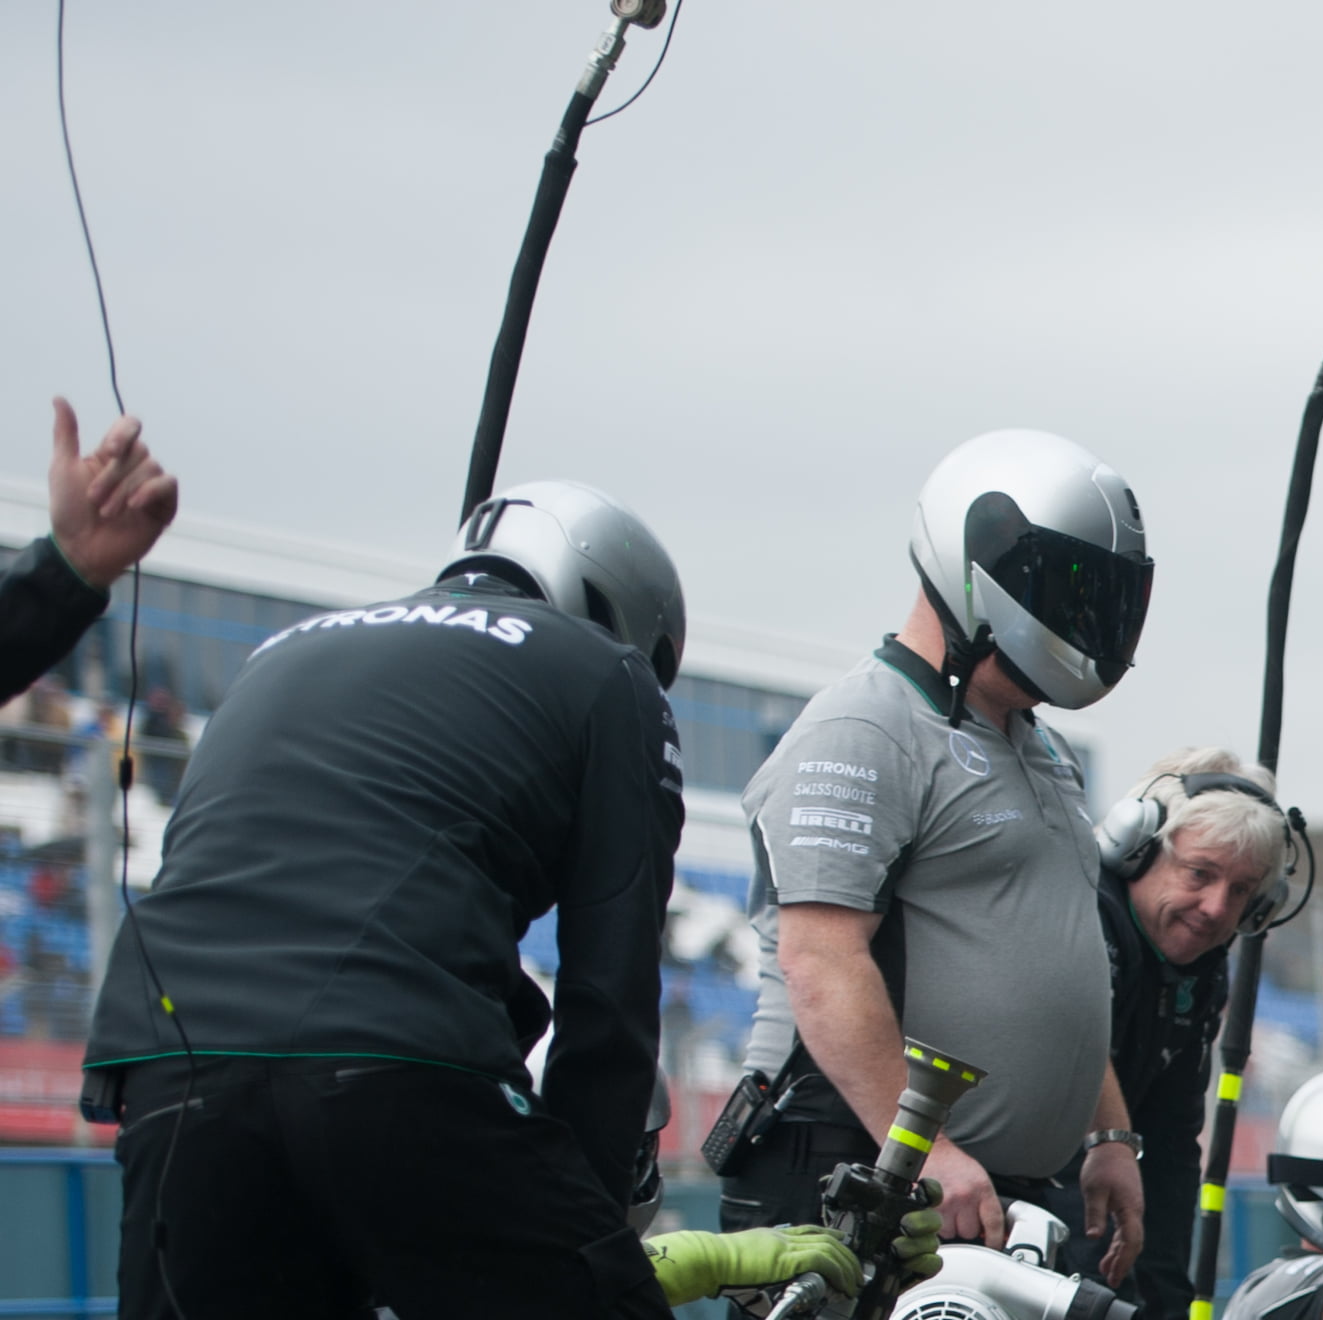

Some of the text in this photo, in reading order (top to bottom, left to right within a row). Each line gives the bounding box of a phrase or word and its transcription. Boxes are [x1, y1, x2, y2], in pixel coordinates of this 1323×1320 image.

[797, 761, 878, 782] PETRONAS
[793, 782, 877, 806] SWISSQUOTE
[790, 807, 874, 834] PIRELLI
